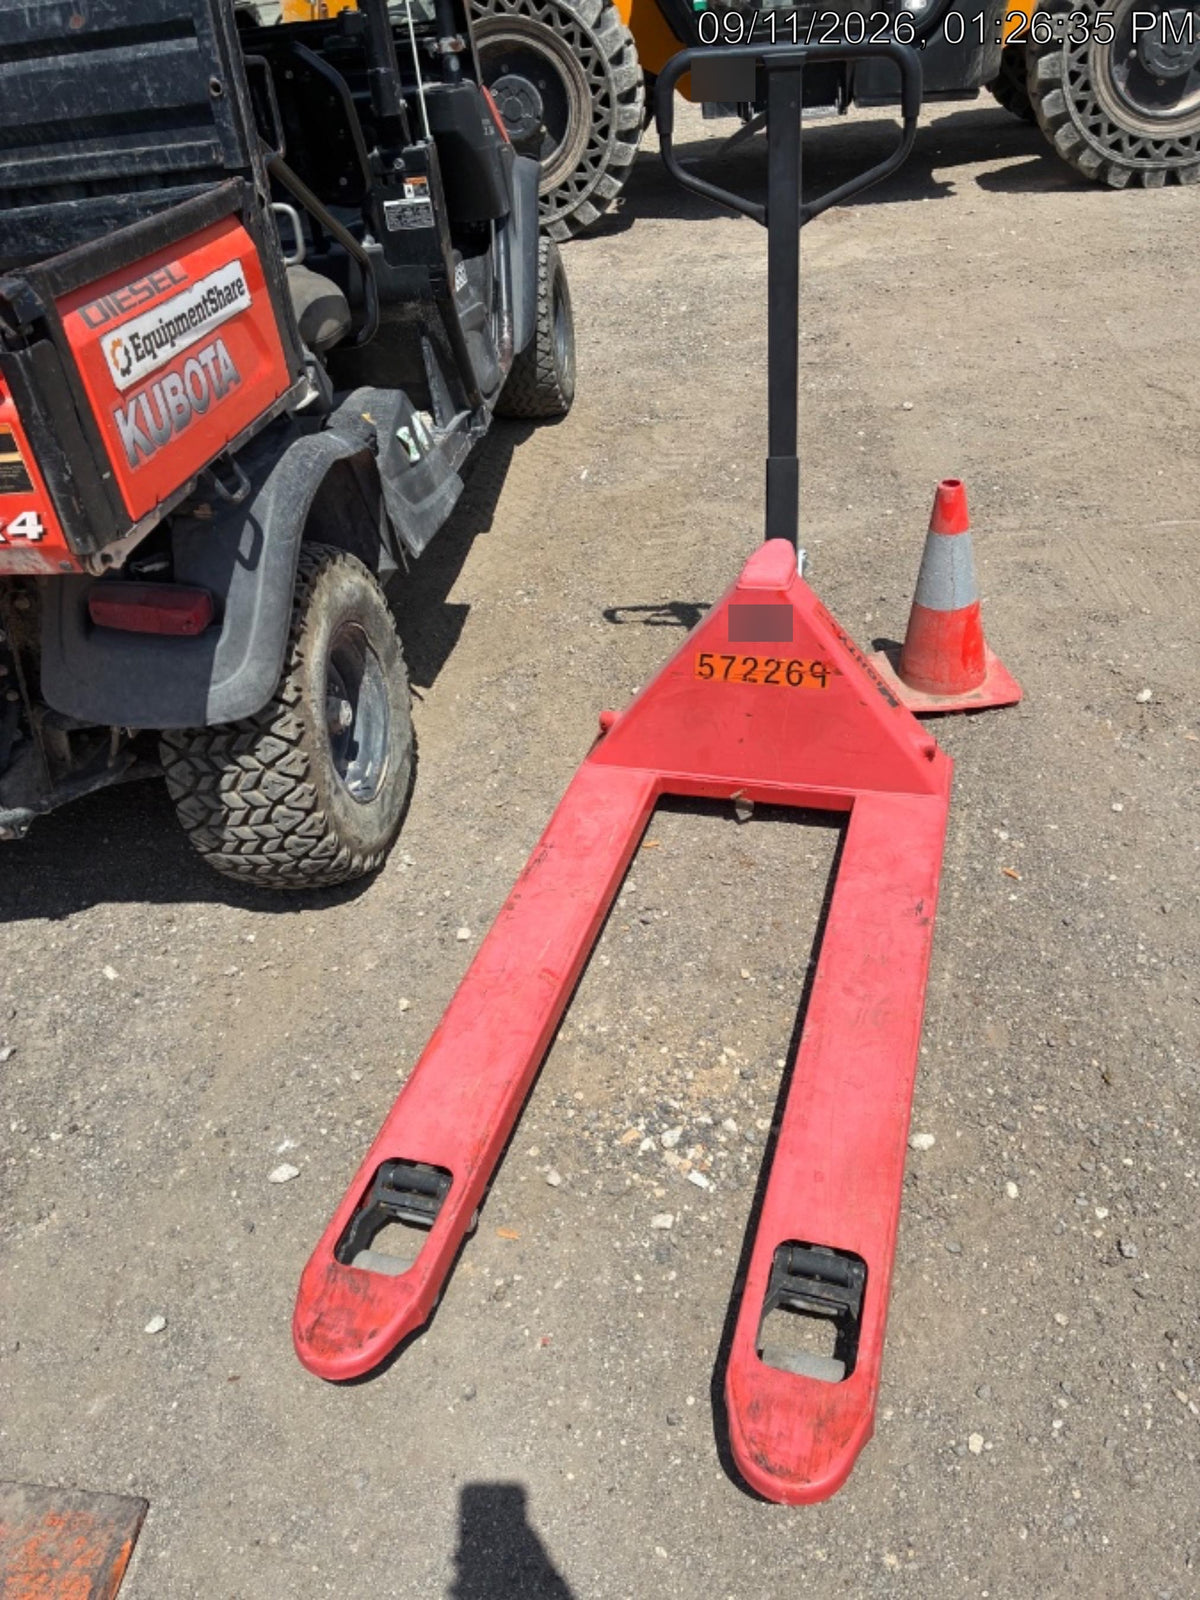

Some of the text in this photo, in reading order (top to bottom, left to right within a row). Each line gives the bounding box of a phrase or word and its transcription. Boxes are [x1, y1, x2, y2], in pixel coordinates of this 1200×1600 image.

[77, 264, 189, 330] DIESEL
[128, 276, 246, 363] EquipmentShare
[113, 338, 242, 469] KUBOTA
[0, 511, 44, 541] 4
[697, 653, 828, 689] 572269
